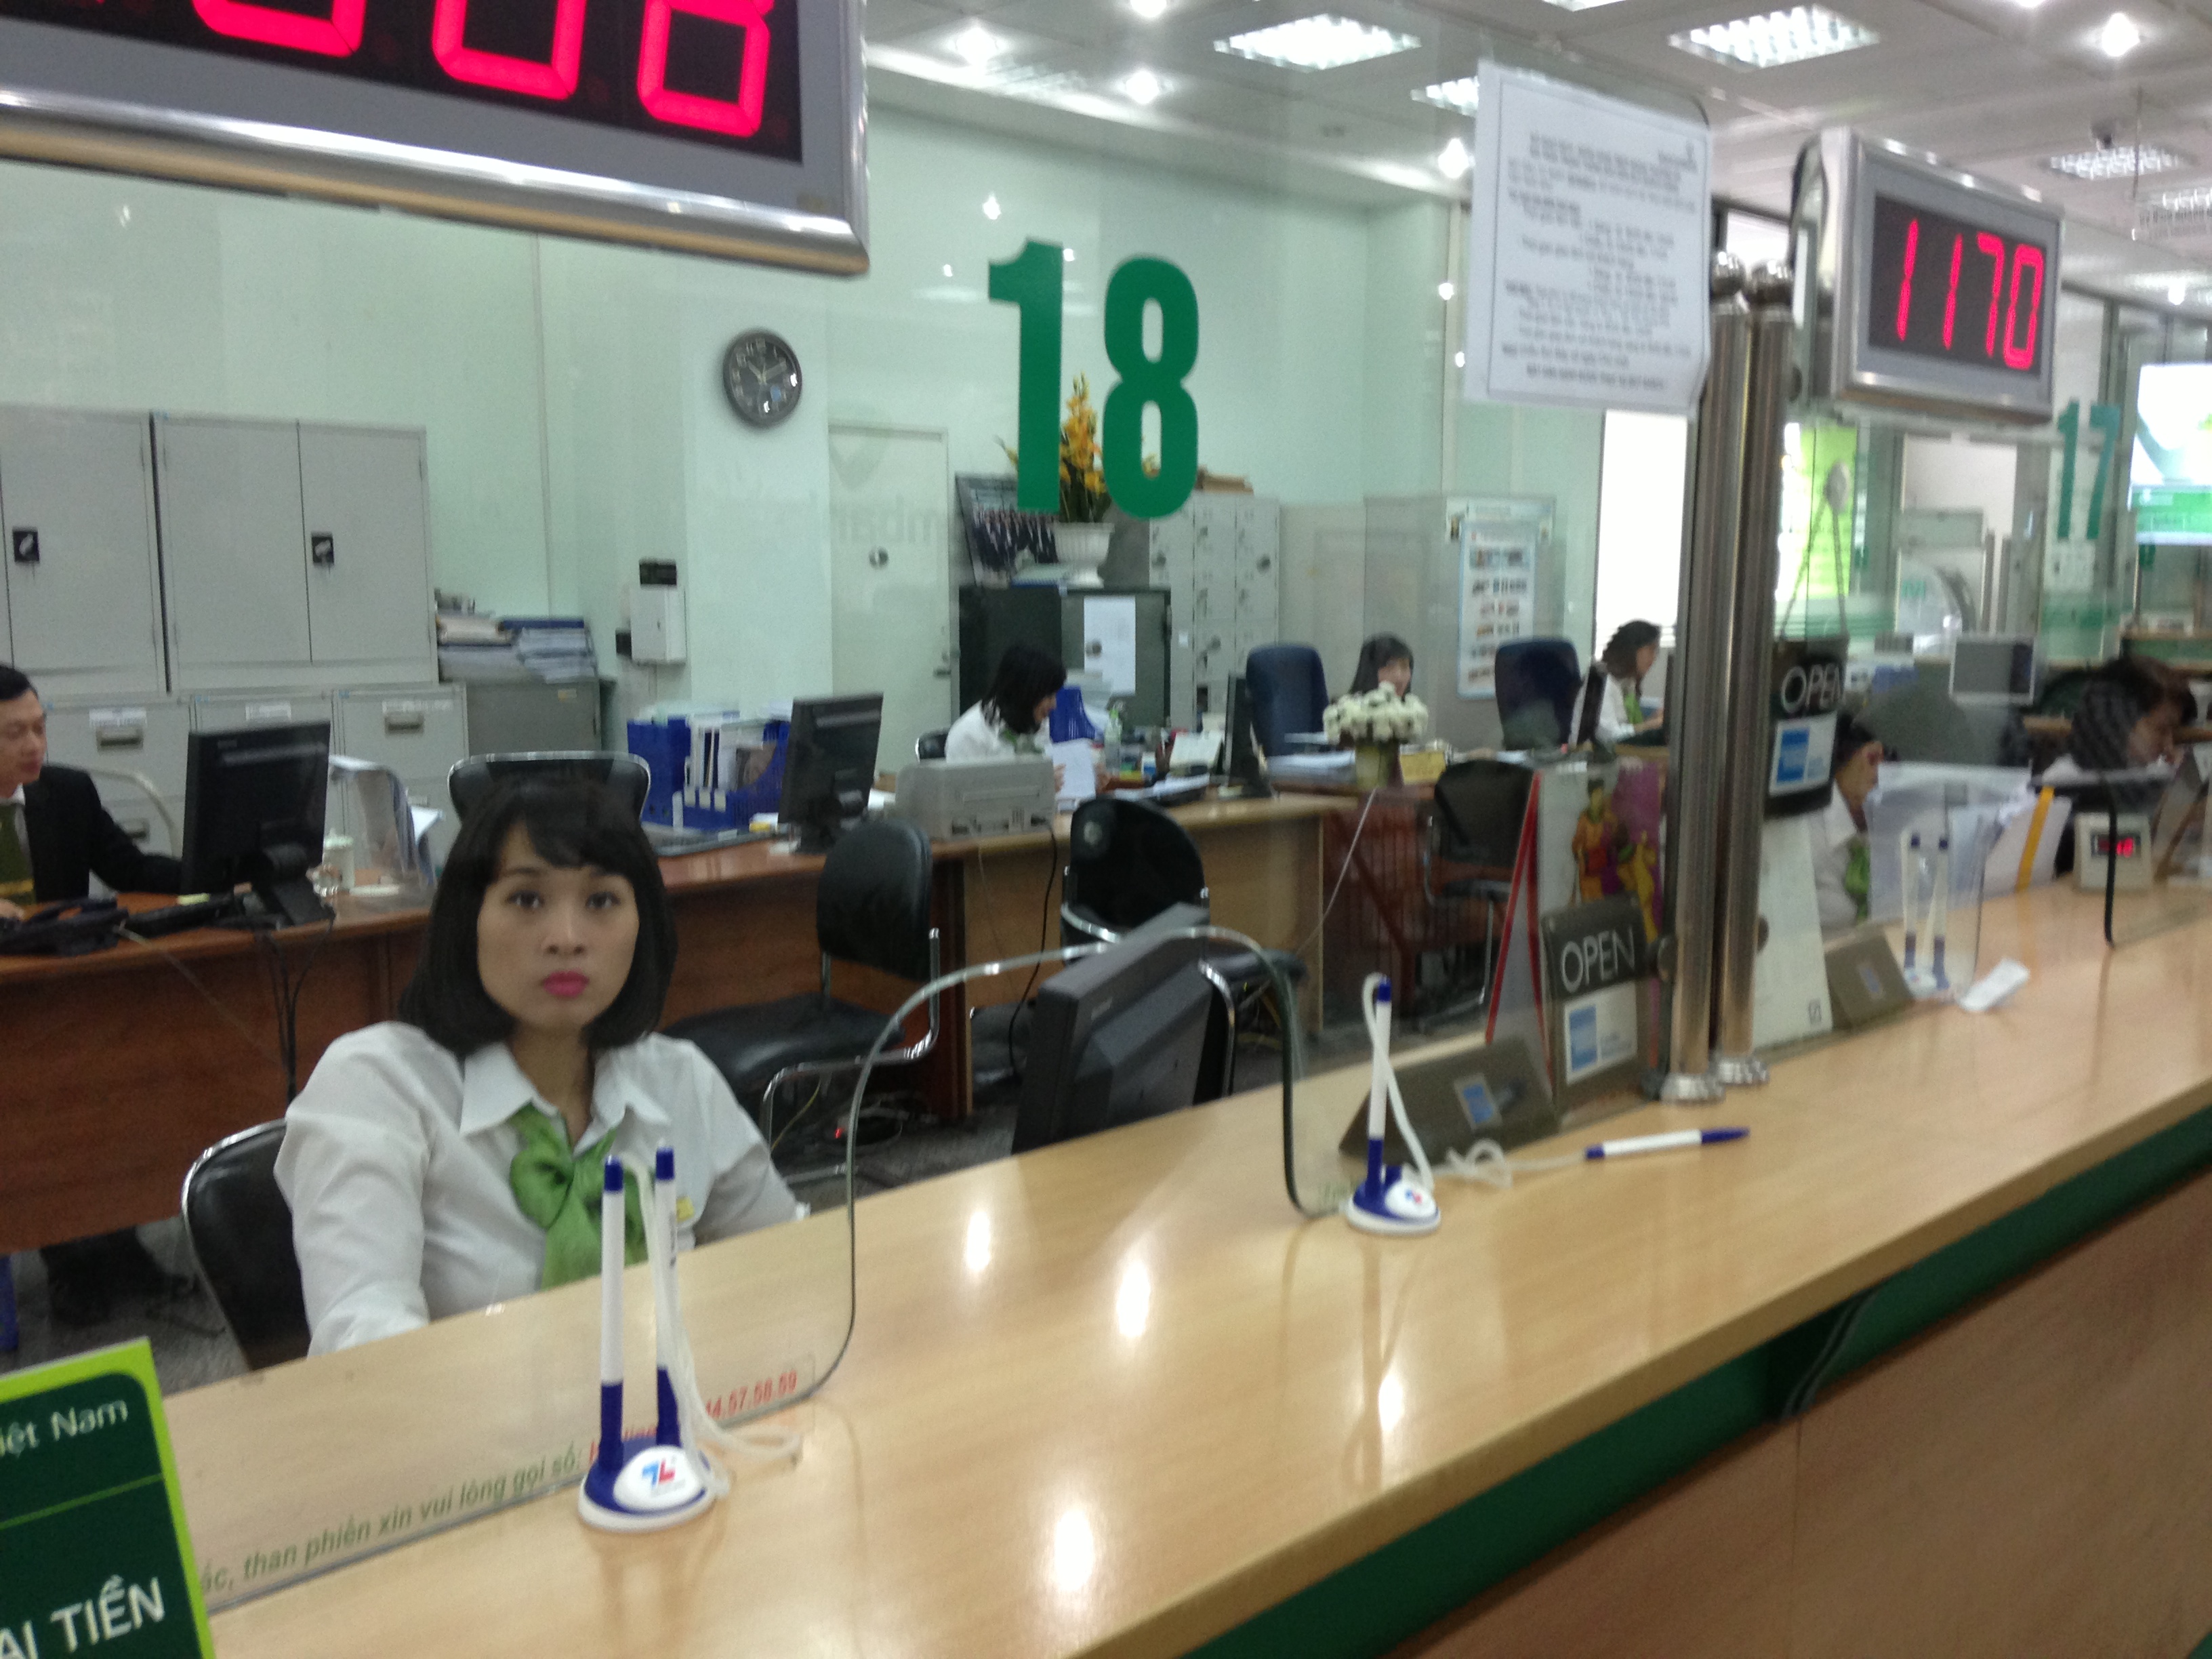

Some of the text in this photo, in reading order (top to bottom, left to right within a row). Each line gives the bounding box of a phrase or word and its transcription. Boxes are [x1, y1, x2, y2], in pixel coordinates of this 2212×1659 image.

[1896, 218, 2045, 371] 1170
[987, 236, 1200, 520] 18
[2056, 398, 2121, 541] 17
[1561, 926, 1636, 994] OPEN
[49, 1399, 129, 1441] Nam
[243, 1542, 298, 1580] than
[377, 1504, 413, 1536] xin
[419, 1484, 453, 1520] vui
[49, 1574, 166, 1653] TIỀN
